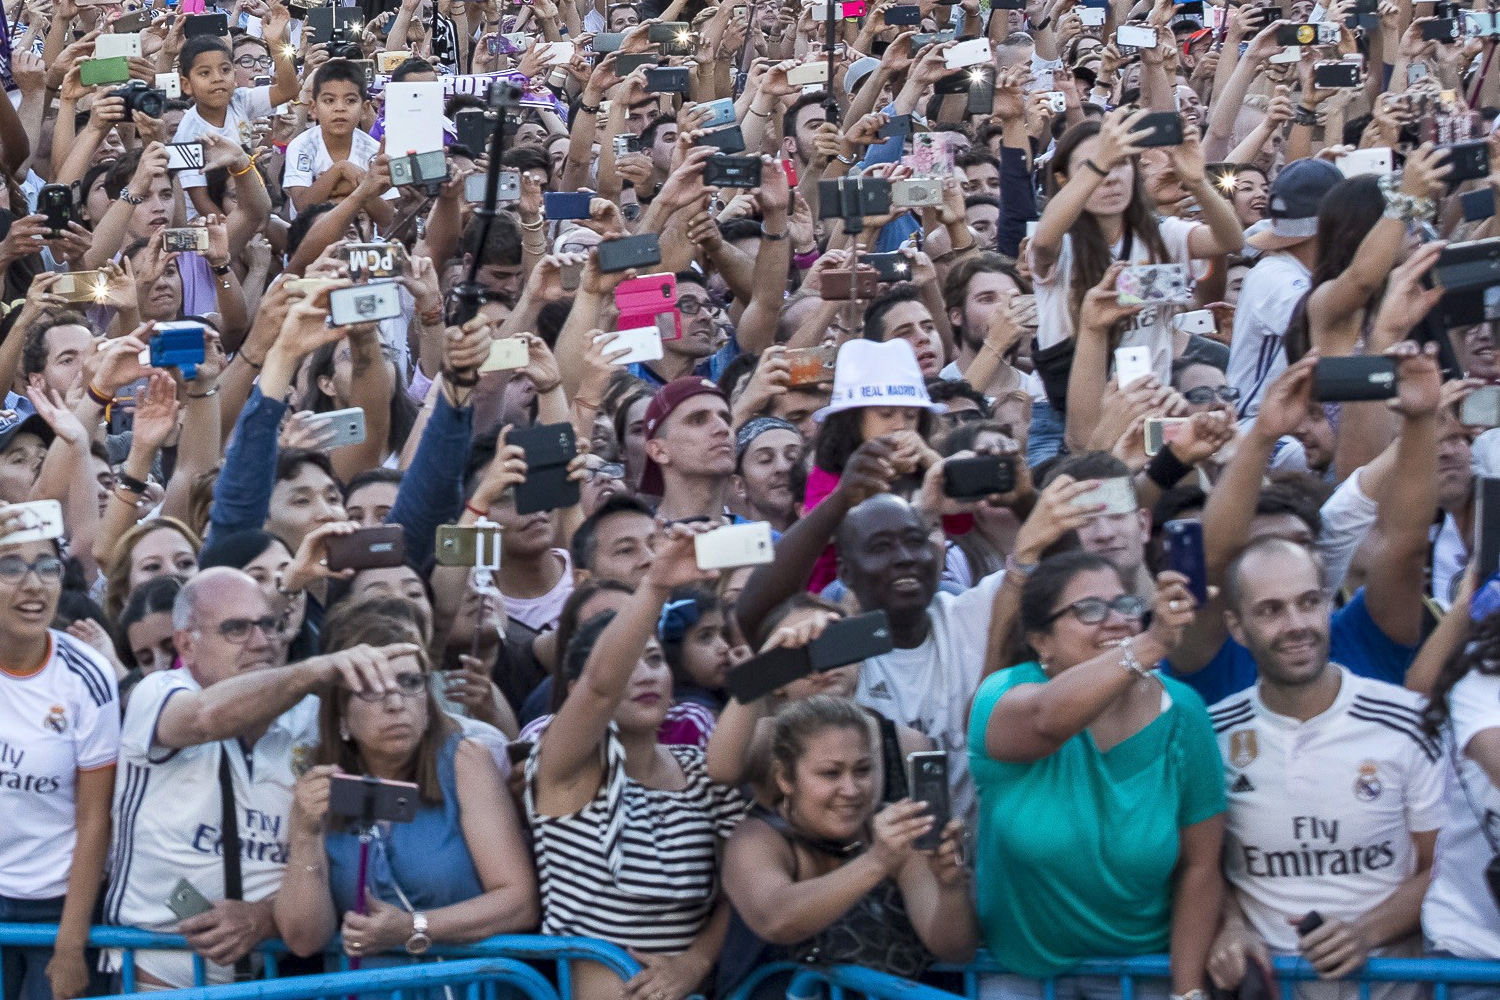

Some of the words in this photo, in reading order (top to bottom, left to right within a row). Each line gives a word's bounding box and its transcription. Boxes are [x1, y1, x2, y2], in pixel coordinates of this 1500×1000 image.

[349, 249, 394, 272] PCM
[861, 385, 884, 397] REAL
[886, 384, 916, 396] MADRID
[245, 808, 281, 839] Fly
[1292, 815, 1340, 844] Fly
[1244, 840, 1395, 878] Emirates
